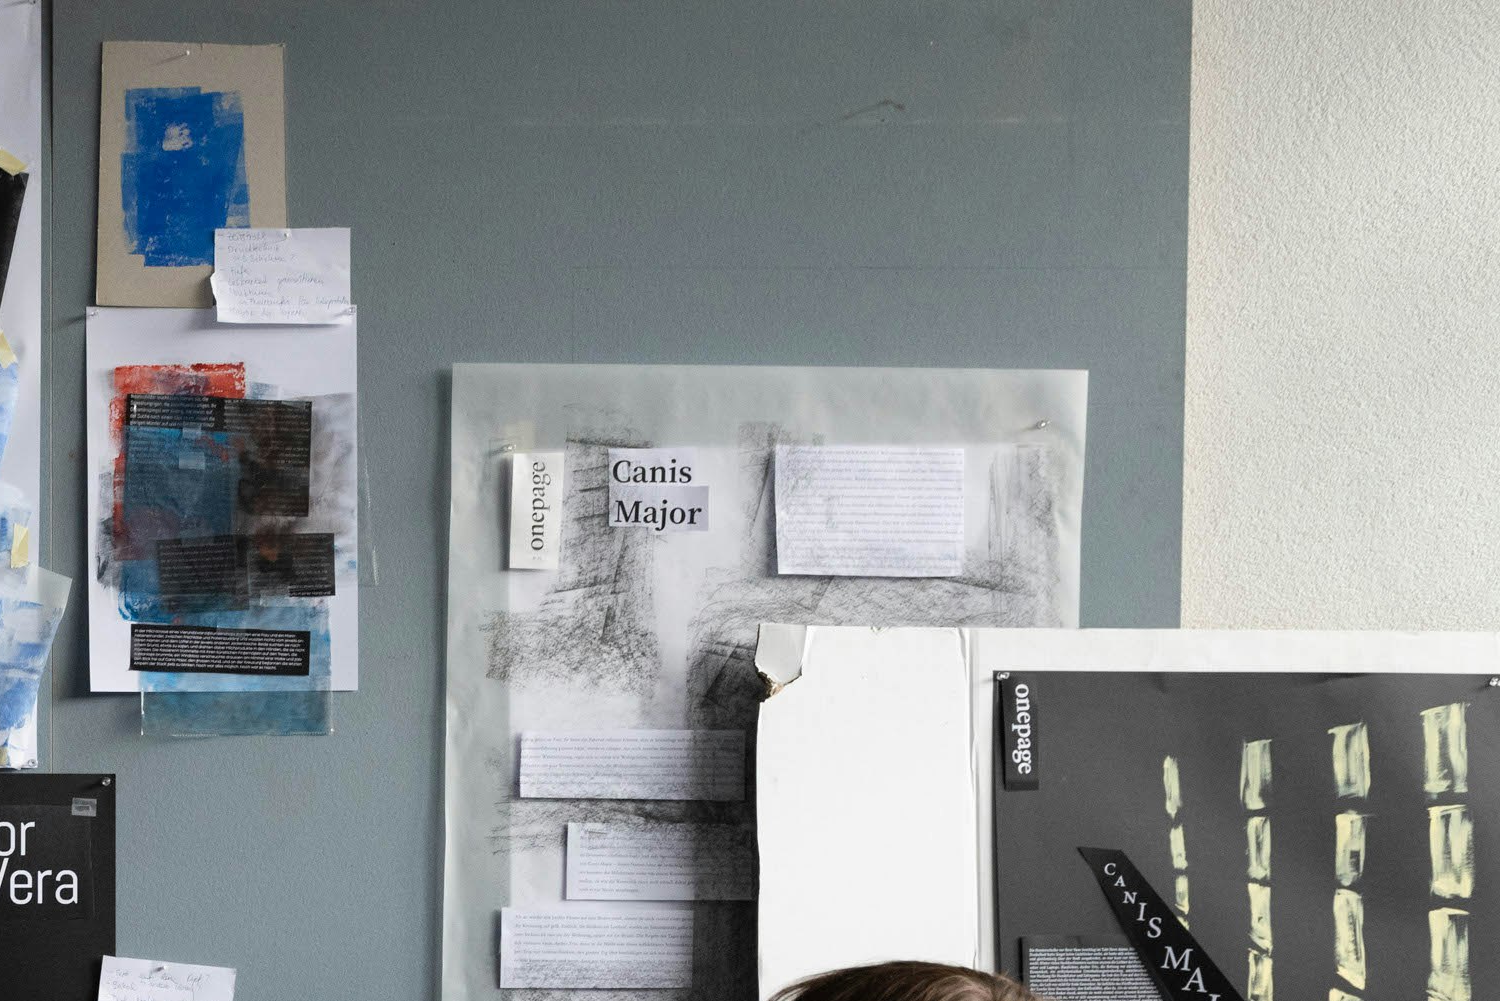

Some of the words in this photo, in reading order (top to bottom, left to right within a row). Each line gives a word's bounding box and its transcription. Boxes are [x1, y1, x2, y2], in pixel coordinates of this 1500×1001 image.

[531, 462, 552, 552] onepage
[612, 459, 692, 484] Canis
[614, 498, 702, 531] Major
[1012, 683, 1032, 775] onepage
[1104, 862, 1162, 938] CANIS
